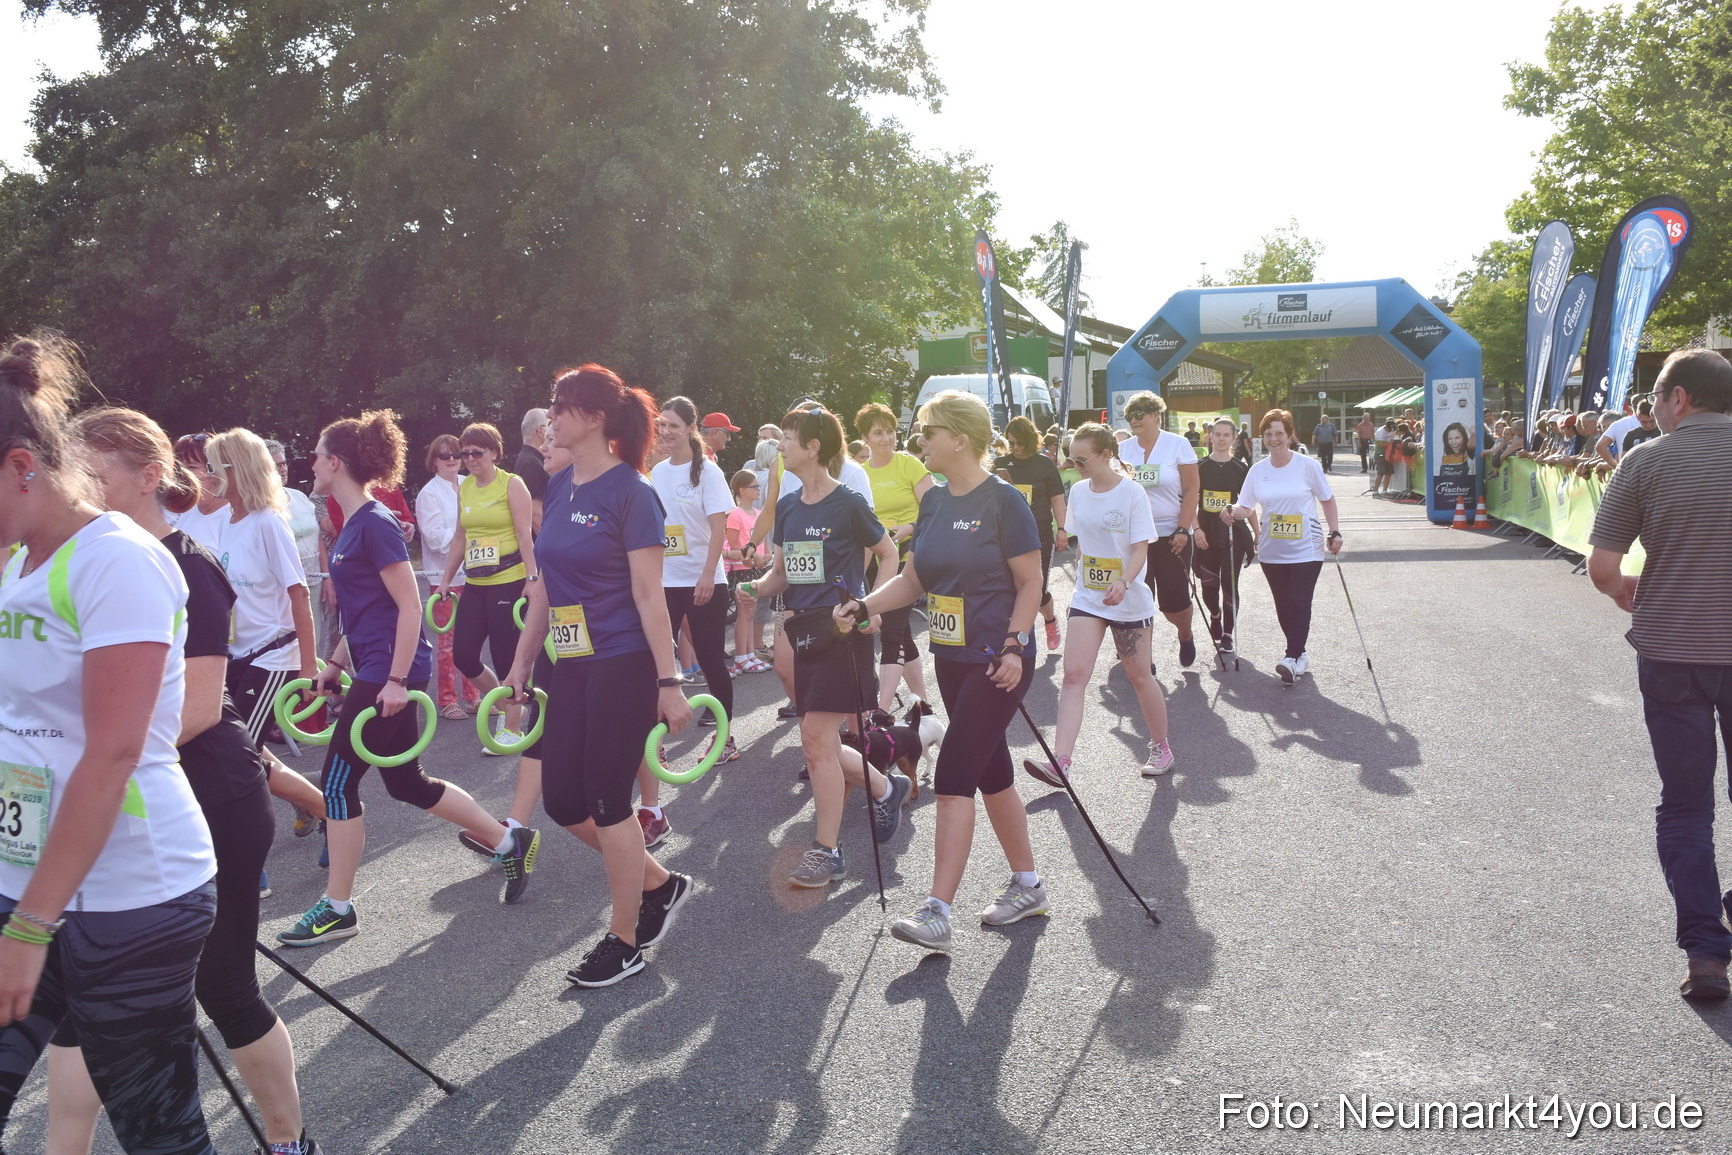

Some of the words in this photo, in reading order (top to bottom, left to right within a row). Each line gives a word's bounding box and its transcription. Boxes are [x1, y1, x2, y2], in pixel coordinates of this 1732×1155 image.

[1540, 236, 1562, 307] Fischer
[1550, 244, 1566, 298] AUTOMOBILE
[1567, 287, 1585, 331] Fischer
[1267, 310, 1333, 324] firmenlauf
[1144, 338, 1179, 347] Fischer
[1132, 471, 1155, 481] 2163
[1441, 485, 1470, 493] Fischer
[1206, 497, 1227, 507] 1985
[571, 511, 588, 524] vhs
[805, 525, 821, 537] vhs
[953, 519, 970, 530] vhs
[1273, 522, 1297, 533] 2171
[665, 536, 677, 548] 93
[468, 547, 495, 560] 1213
[786, 556, 817, 572] 2393
[1089, 568, 1112, 582] 687
[0, 610, 48, 642] art
[930, 610, 956, 632] 2400
[551, 623, 579, 643] 2397
